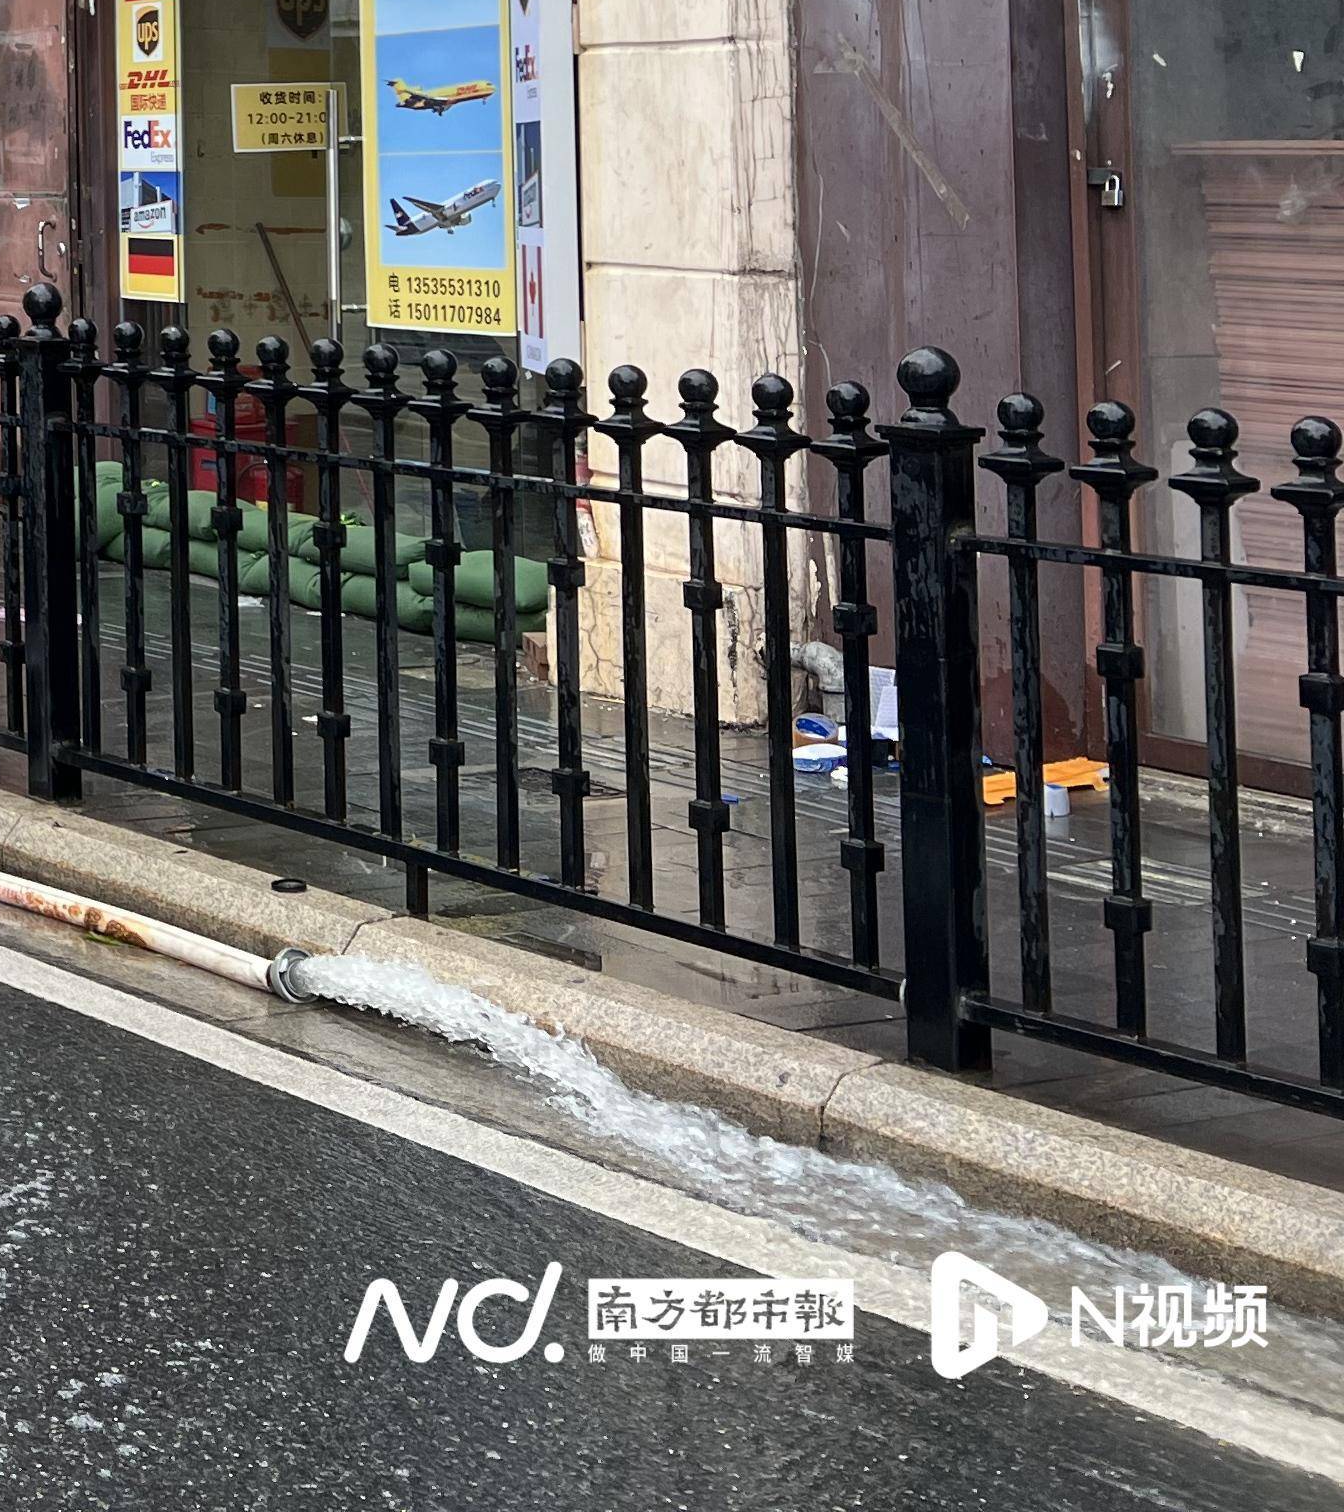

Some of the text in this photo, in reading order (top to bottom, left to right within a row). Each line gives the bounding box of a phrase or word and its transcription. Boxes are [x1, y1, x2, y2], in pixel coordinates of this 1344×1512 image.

[137, 21, 159, 50] ups
[127, 69, 171, 90] DHL
[130, 93, 167, 111] 国际快递
[247, 111, 327, 125] 12:00-21:0
[124, 120, 172, 149] FedEx
[133, 206, 167, 222] amazon
[407, 277, 500, 298] 13535531310
[407, 303, 501, 325] 15011707984
